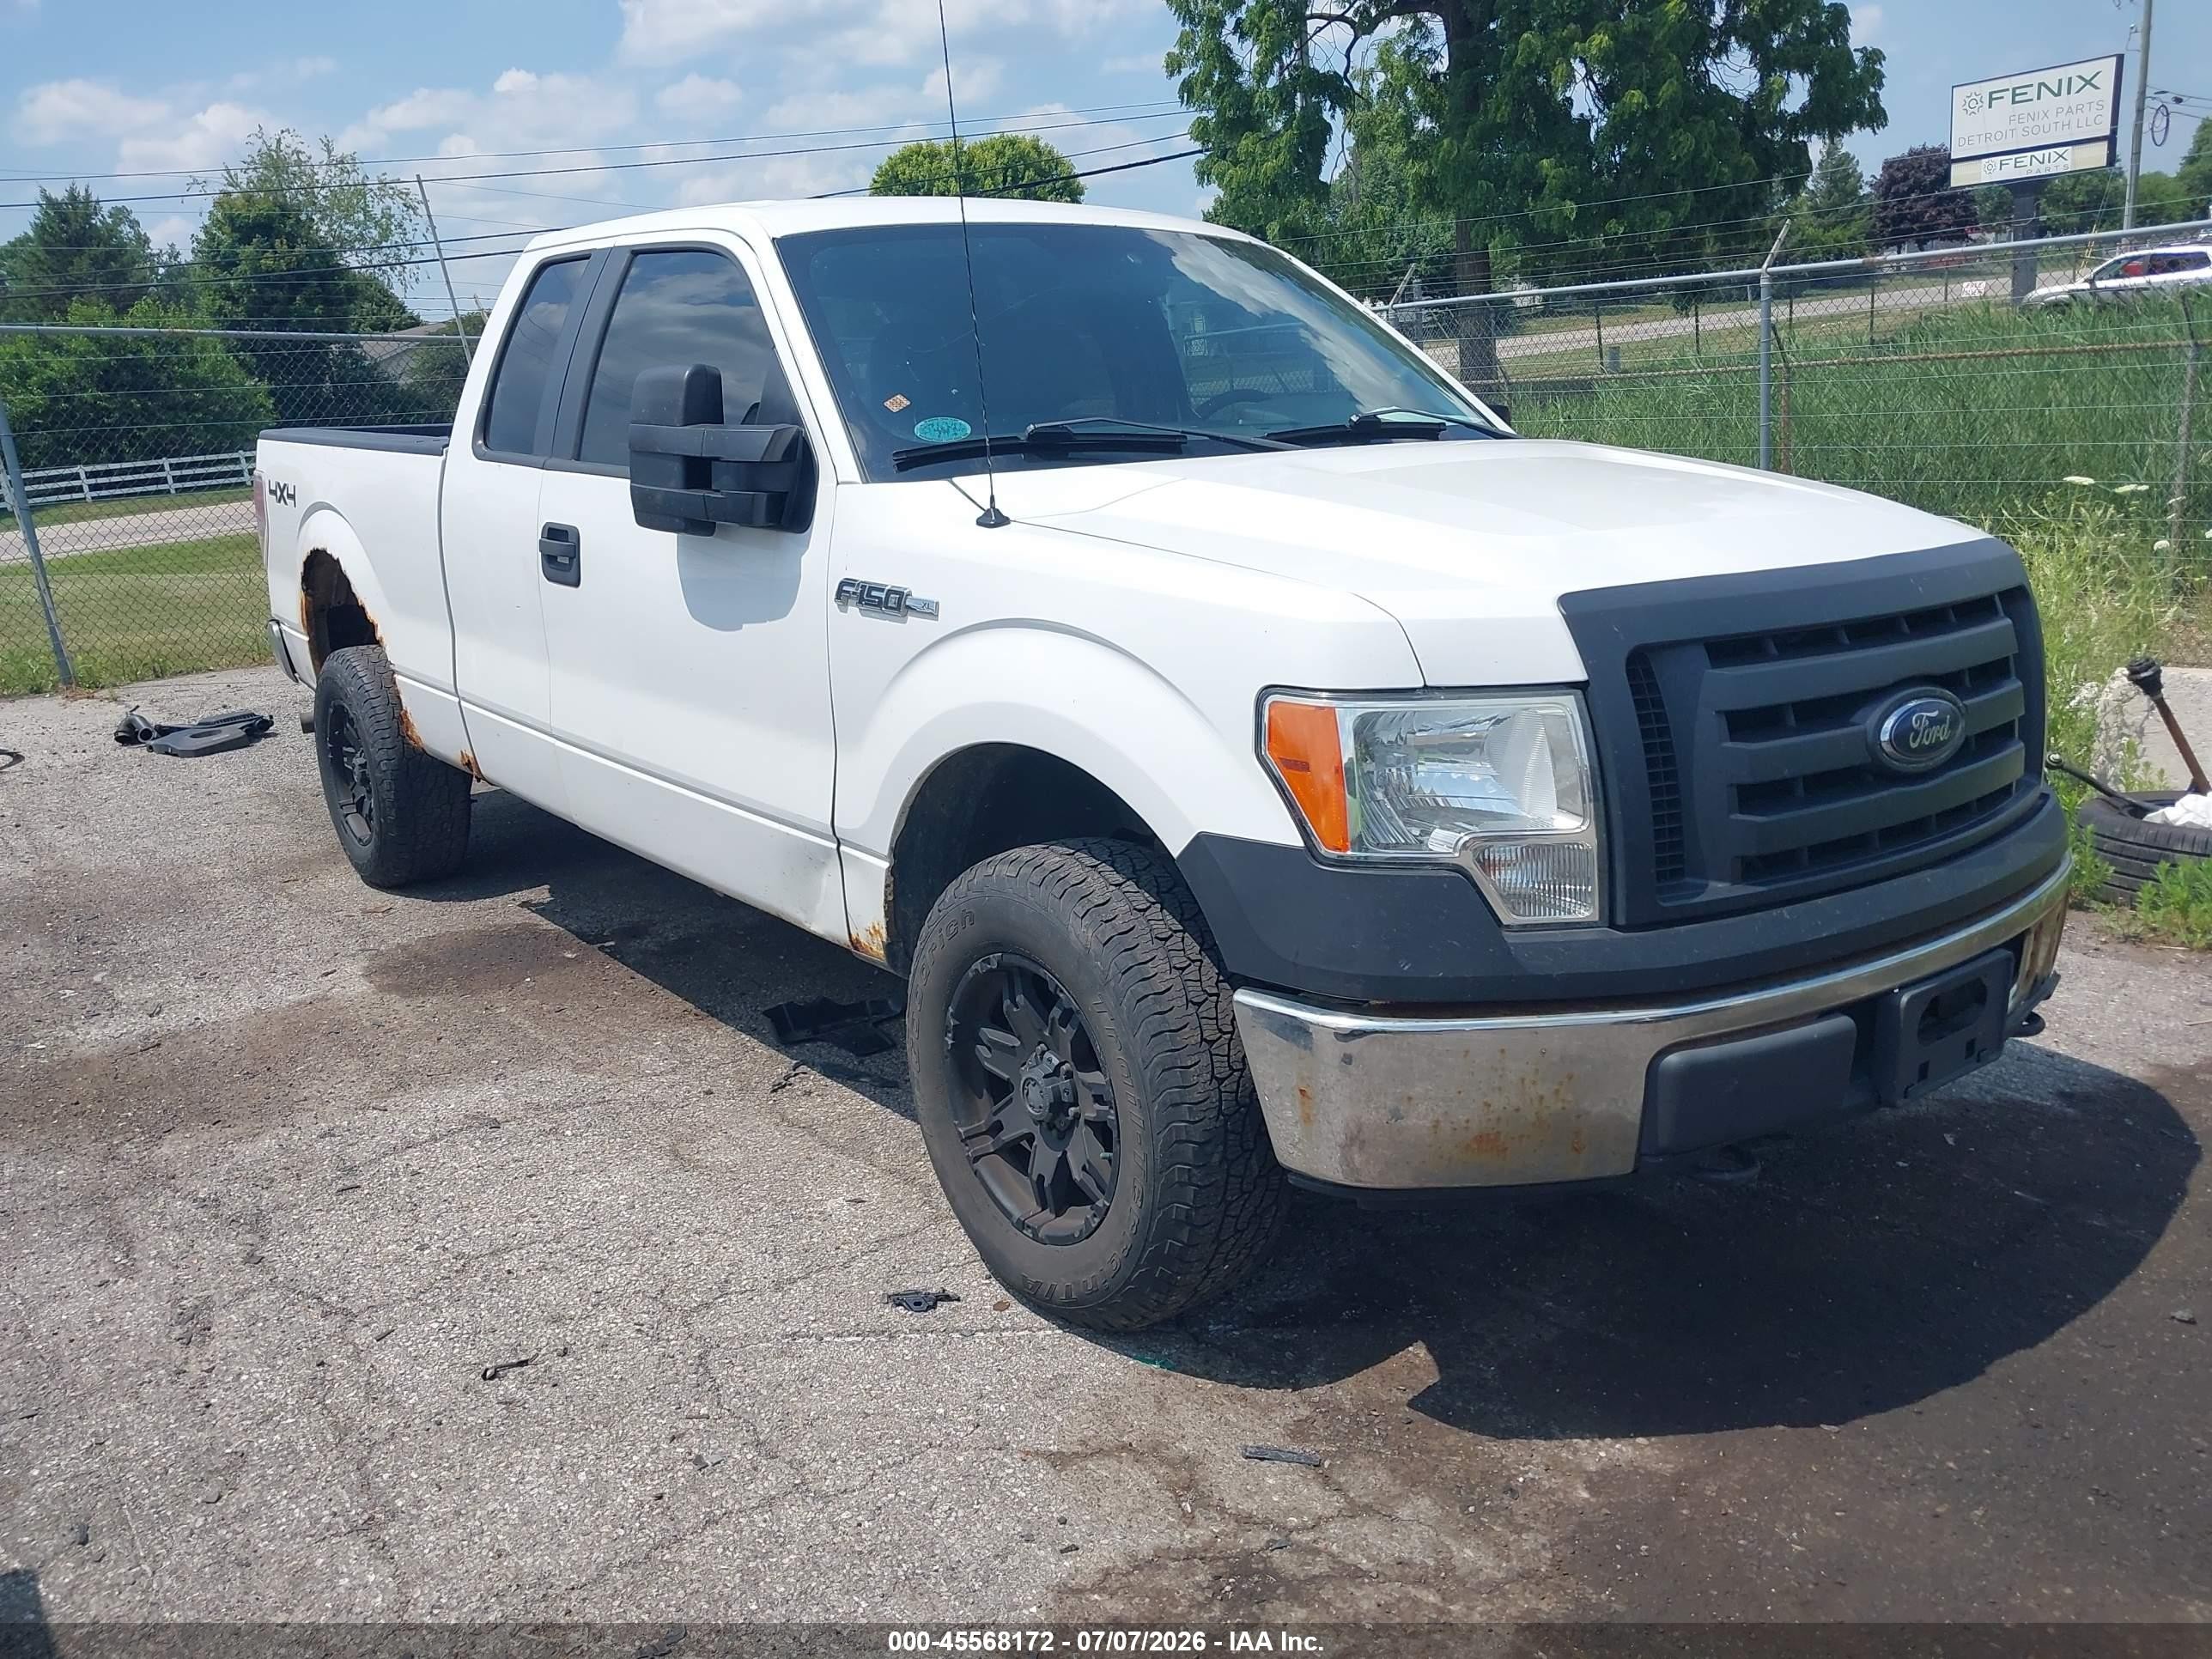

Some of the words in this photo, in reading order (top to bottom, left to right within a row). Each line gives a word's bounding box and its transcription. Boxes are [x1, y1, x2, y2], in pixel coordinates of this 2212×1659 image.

[1987, 70, 2103, 110] FENIX
[2008, 109, 2050, 125] FENIX
[2056, 100, 2105, 118] PARTS
[1958, 128, 2017, 148] DETROIT
[2021, 118, 2071, 137] SOUTH
[2076, 113, 2104, 129] LLC
[1999, 149, 2069, 171] FENIX
[2026, 163, 2069, 176] PARTS
[1909, 709, 1951, 749] Ford
